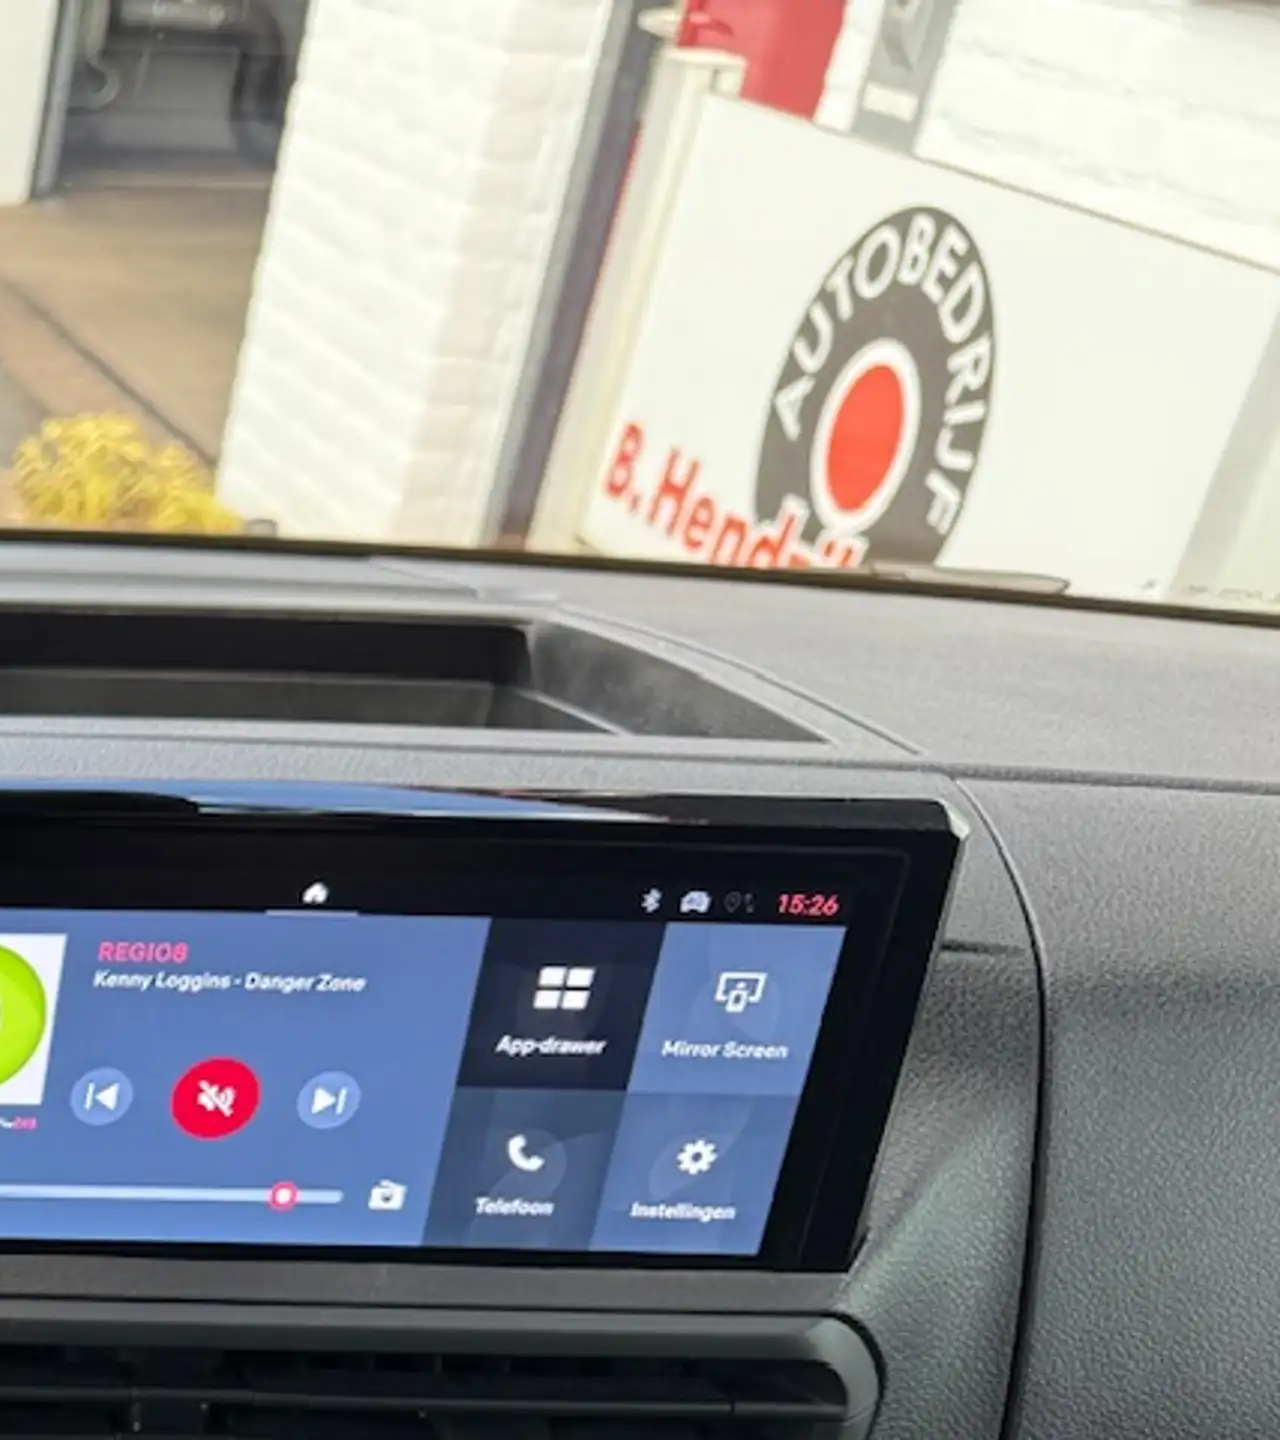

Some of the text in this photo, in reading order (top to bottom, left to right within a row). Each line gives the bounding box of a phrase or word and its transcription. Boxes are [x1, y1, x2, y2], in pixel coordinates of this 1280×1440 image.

[773, 210, 992, 535] AUTOBEDRIJF
[778, 893, 839, 917] 15:26
[92, 968, 152, 991] Kenny
[154, 970, 231, 992] Loggins
[244, 971, 314, 995] Danger
[314, 974, 367, 993] Zone
[495, 1035, 608, 1056] App-drawer
[660, 1040, 789, 1060] Mirror Screen
[475, 1197, 555, 1217] Telefoon
[629, 1202, 737, 1223] Instellingen
